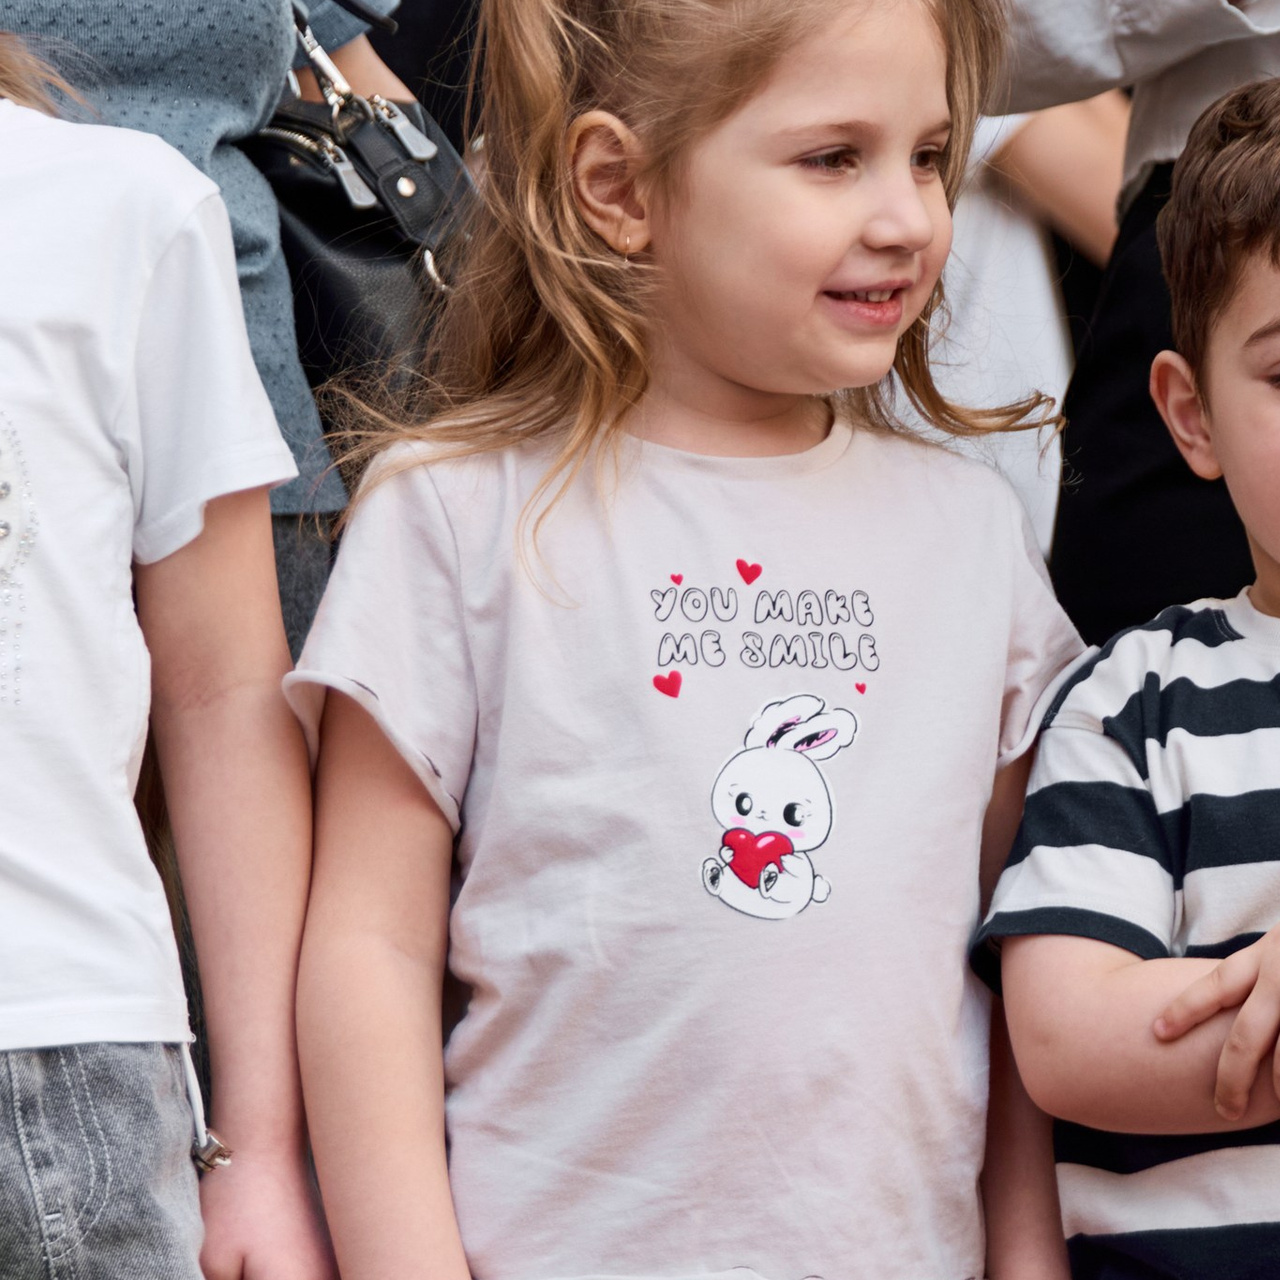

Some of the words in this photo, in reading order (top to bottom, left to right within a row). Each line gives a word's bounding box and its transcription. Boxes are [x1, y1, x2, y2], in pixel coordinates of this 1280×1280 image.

[651, 587, 737, 622] YOU
[754, 589, 874, 627] MAKE
[658, 630, 726, 667] ME
[740, 631, 880, 671] SMILE
